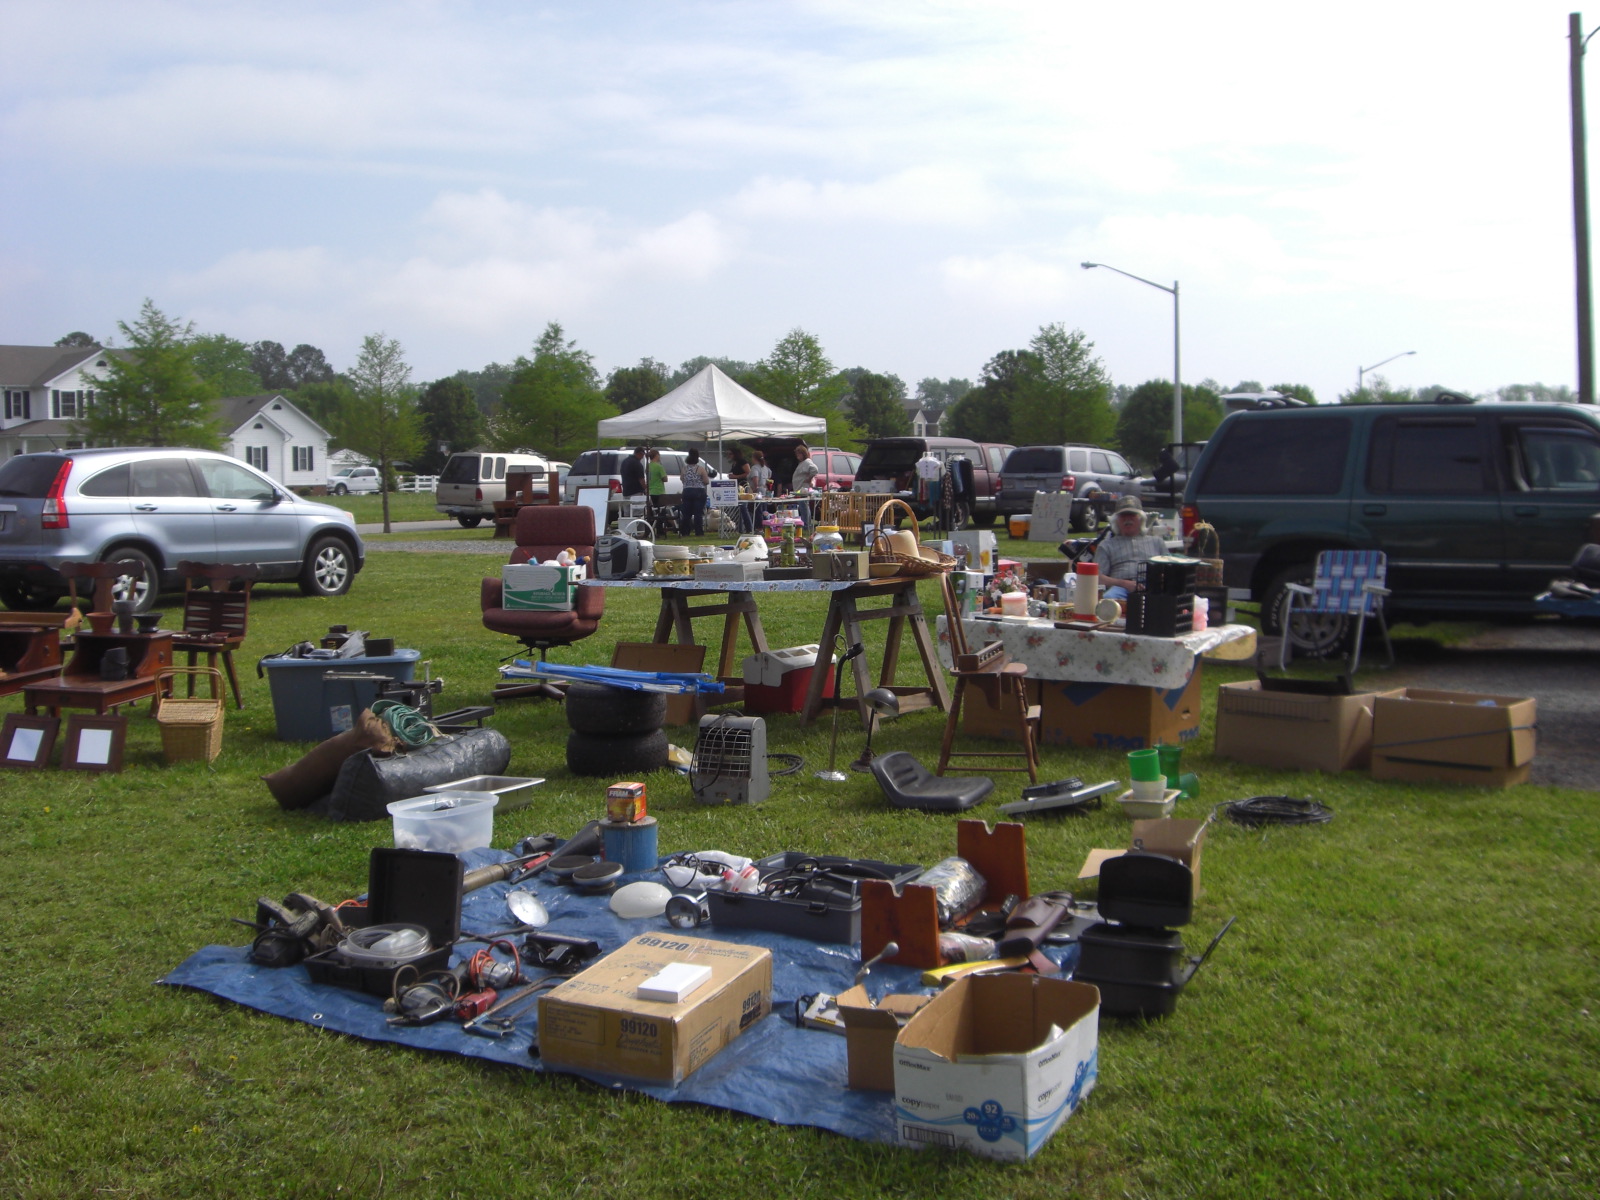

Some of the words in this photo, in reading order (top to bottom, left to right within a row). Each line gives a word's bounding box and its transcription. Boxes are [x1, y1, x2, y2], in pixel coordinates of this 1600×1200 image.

[637, 937, 689, 951] 99120
[742, 990, 761, 1013] 99120
[620, 1018, 658, 1037] 99120
[899, 1059, 931, 1071] OfficeMax
[1038, 1051, 1061, 1068] OfficeMax
[985, 1104, 998, 1114] 92
